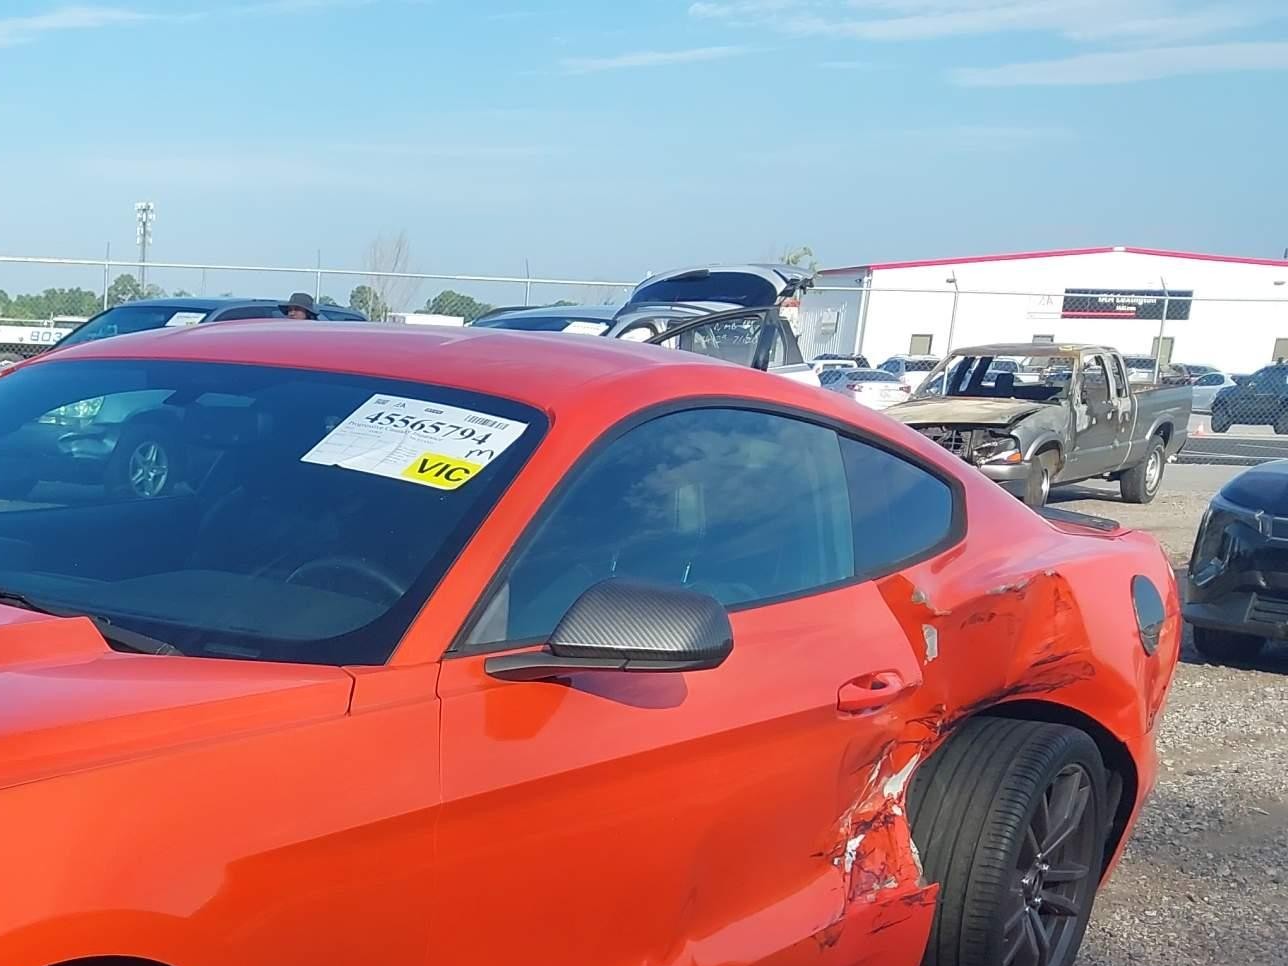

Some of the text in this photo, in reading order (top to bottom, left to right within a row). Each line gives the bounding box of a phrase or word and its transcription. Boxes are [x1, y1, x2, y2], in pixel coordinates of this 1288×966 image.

[30, 330, 63, 342] 803
[365, 410, 493, 446] 45565794
[416, 458, 471, 482] VIC
